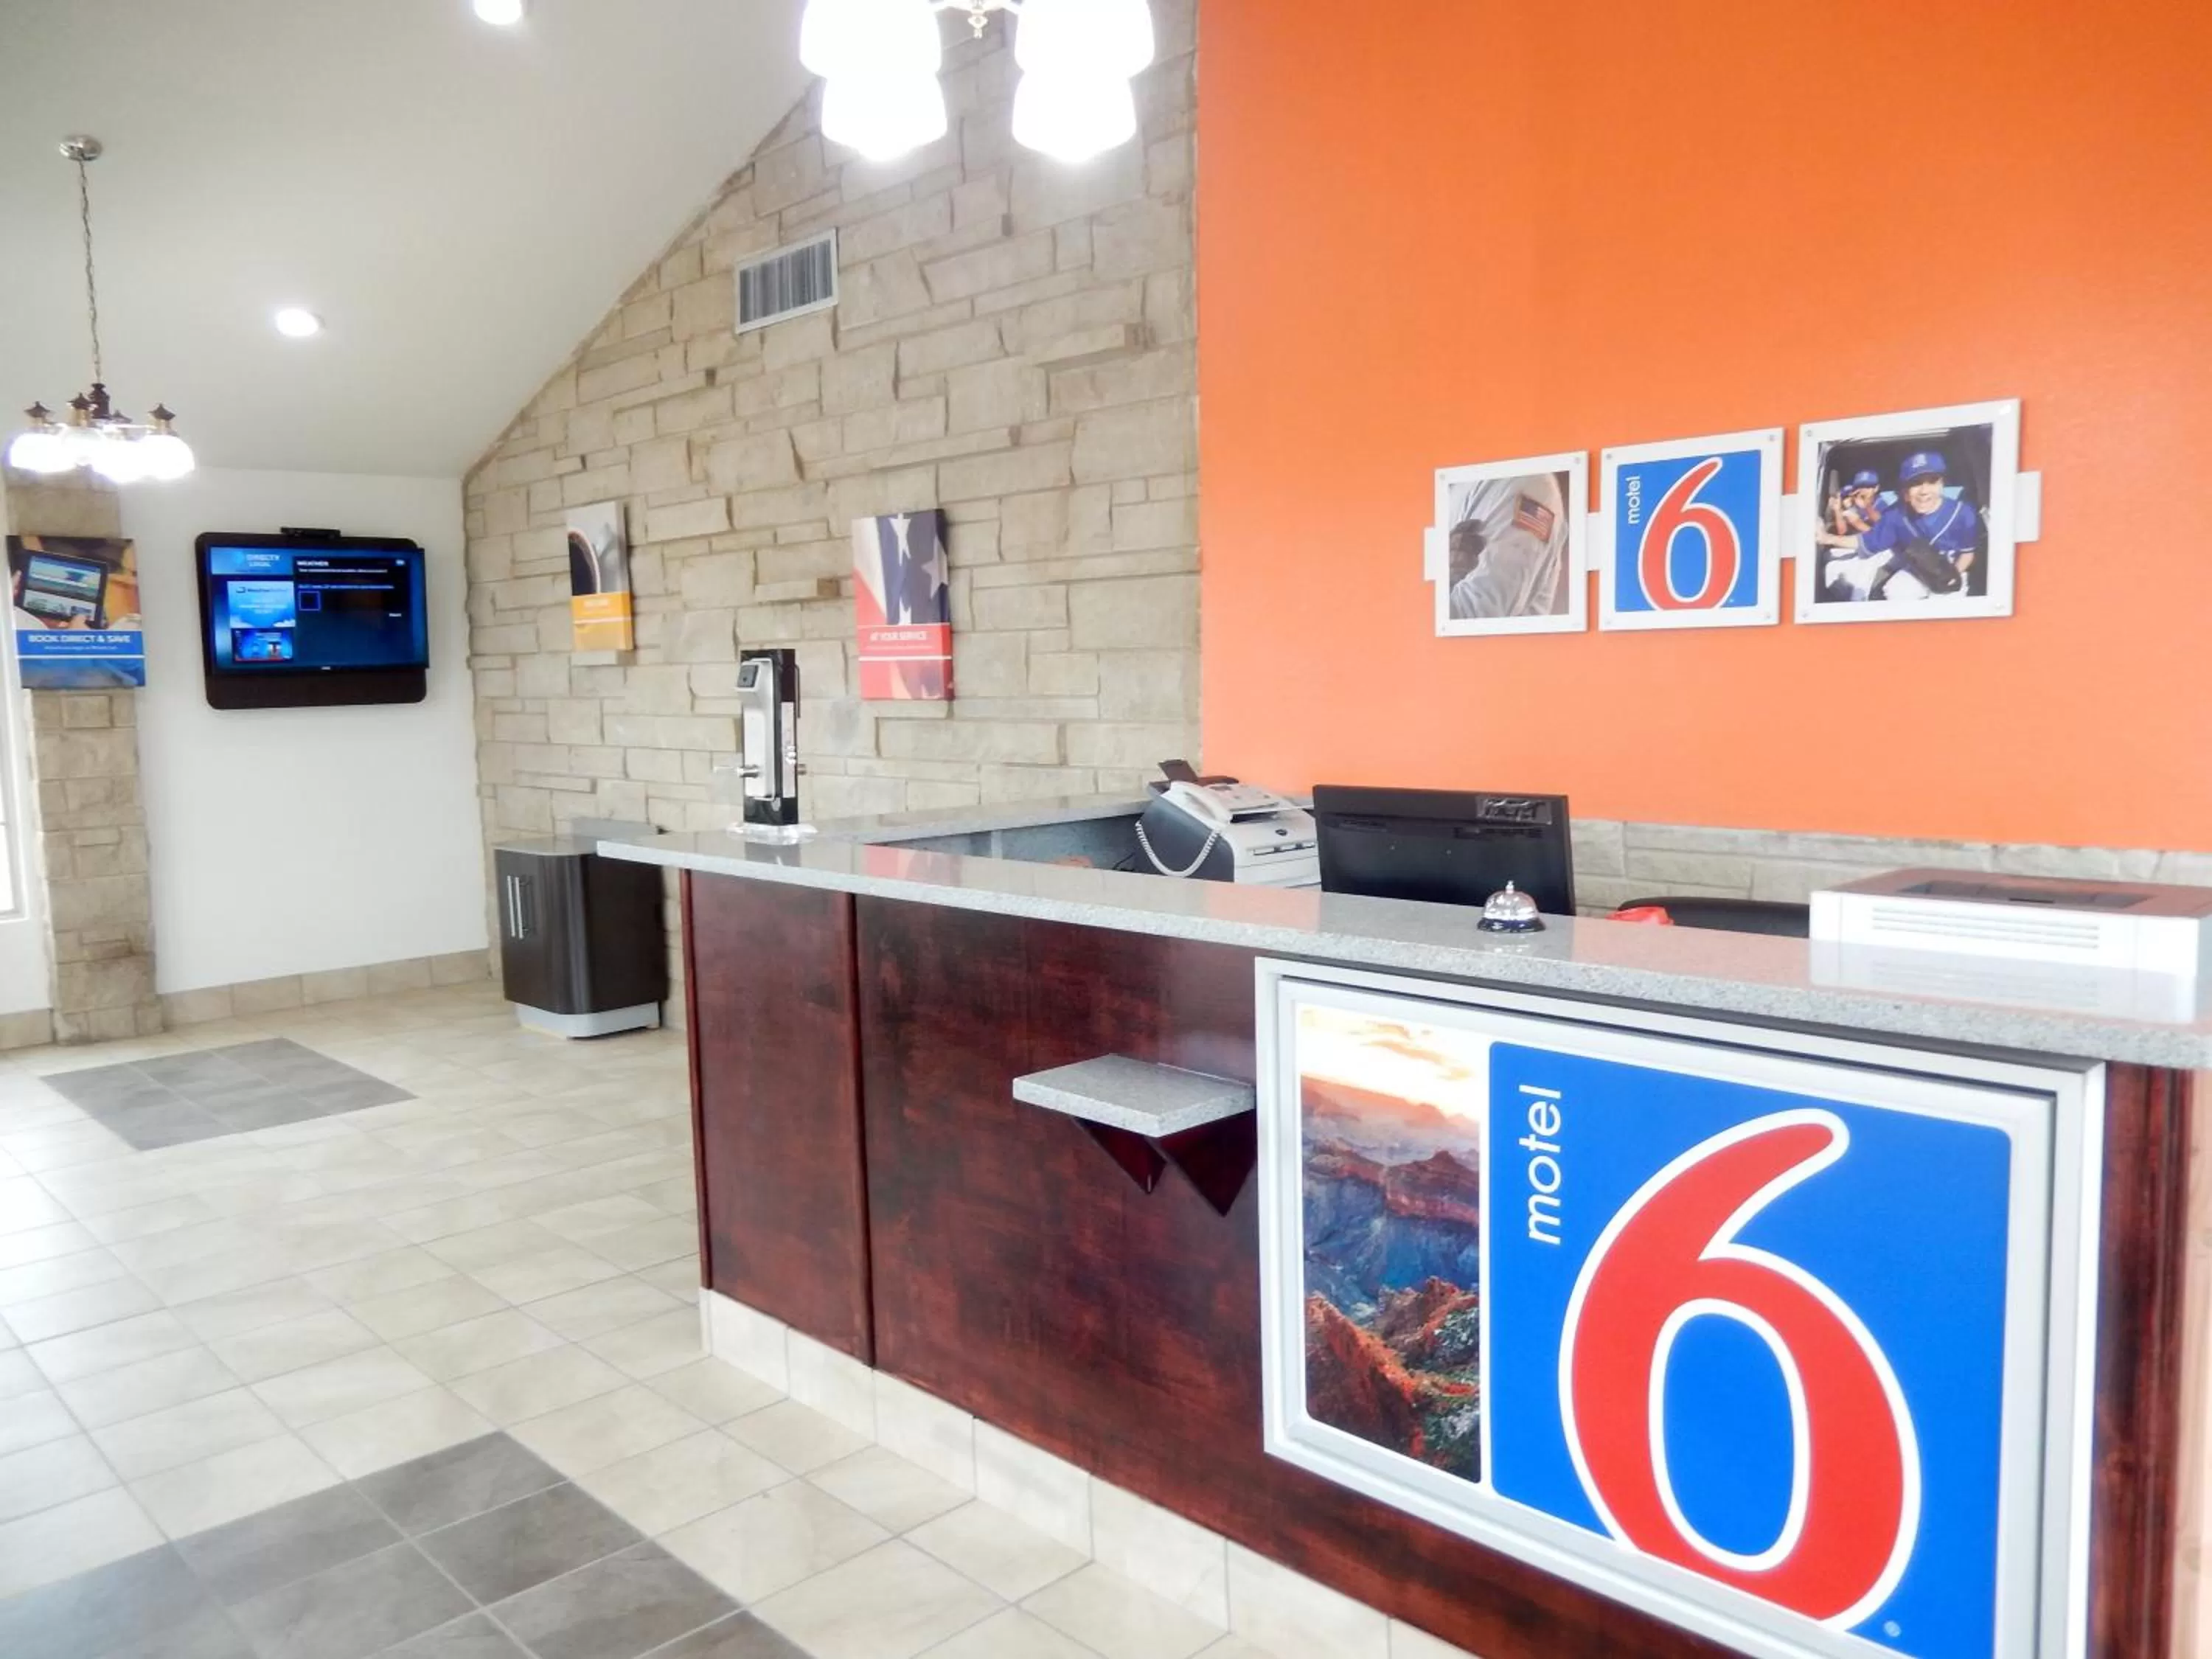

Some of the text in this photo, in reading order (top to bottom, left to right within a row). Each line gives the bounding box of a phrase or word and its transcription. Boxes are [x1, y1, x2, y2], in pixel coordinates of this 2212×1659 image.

[1625, 456, 1741, 611] motel 6
[28, 635, 59, 643] BOOK
[60, 635, 95, 643] DIRECT
[106, 635, 131, 643] SAVE
[1518, 1084, 1921, 1632] motel 6
